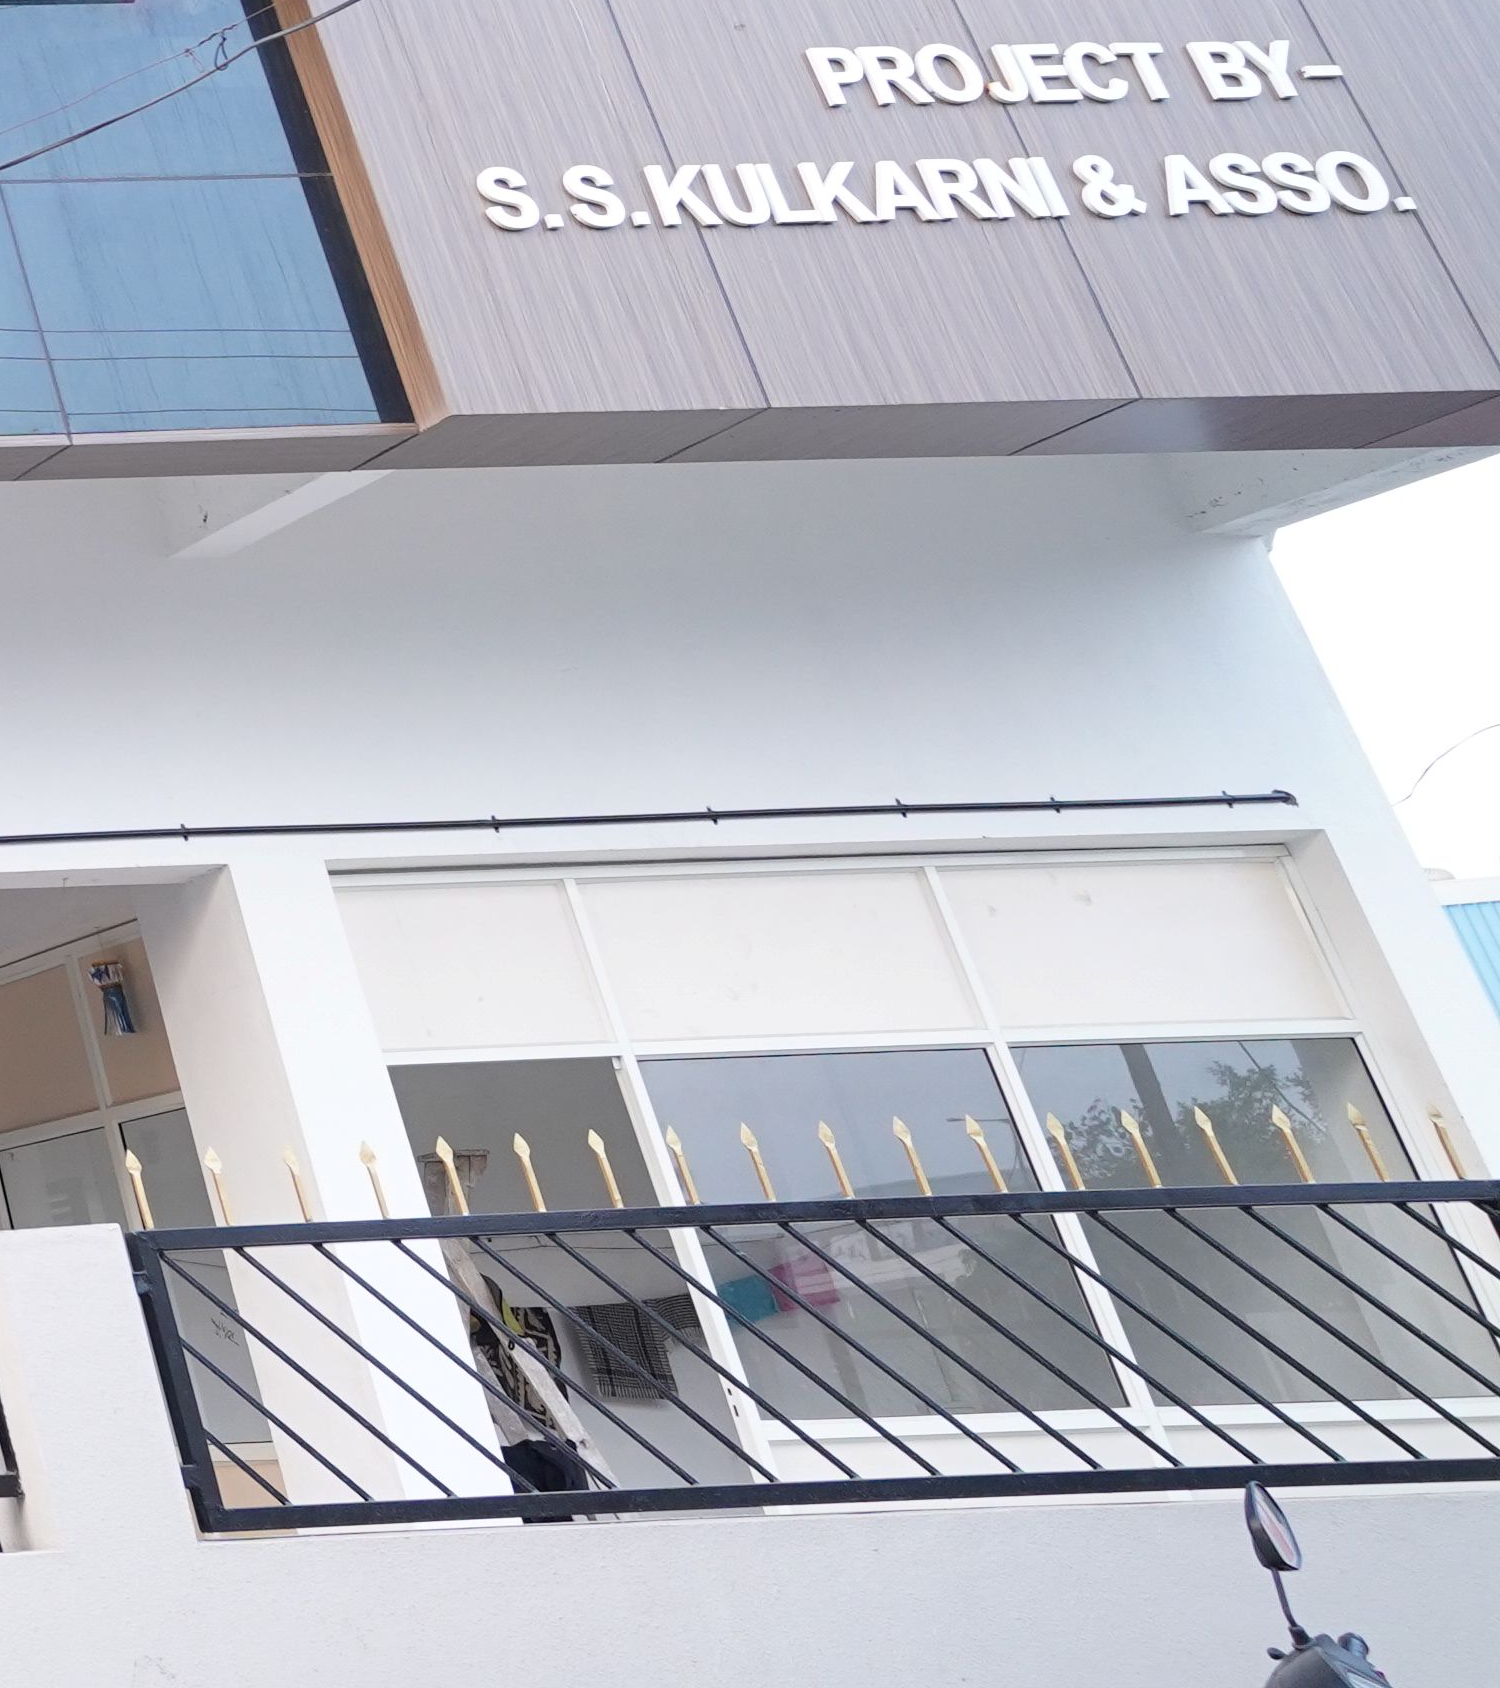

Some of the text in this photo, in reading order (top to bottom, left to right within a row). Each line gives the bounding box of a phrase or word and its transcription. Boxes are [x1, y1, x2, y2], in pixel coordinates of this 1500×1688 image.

[805, 41, 1171, 108] PROJECT
[1071, 155, 1148, 219] &
[1165, 151, 1417, 219] ASSO.
